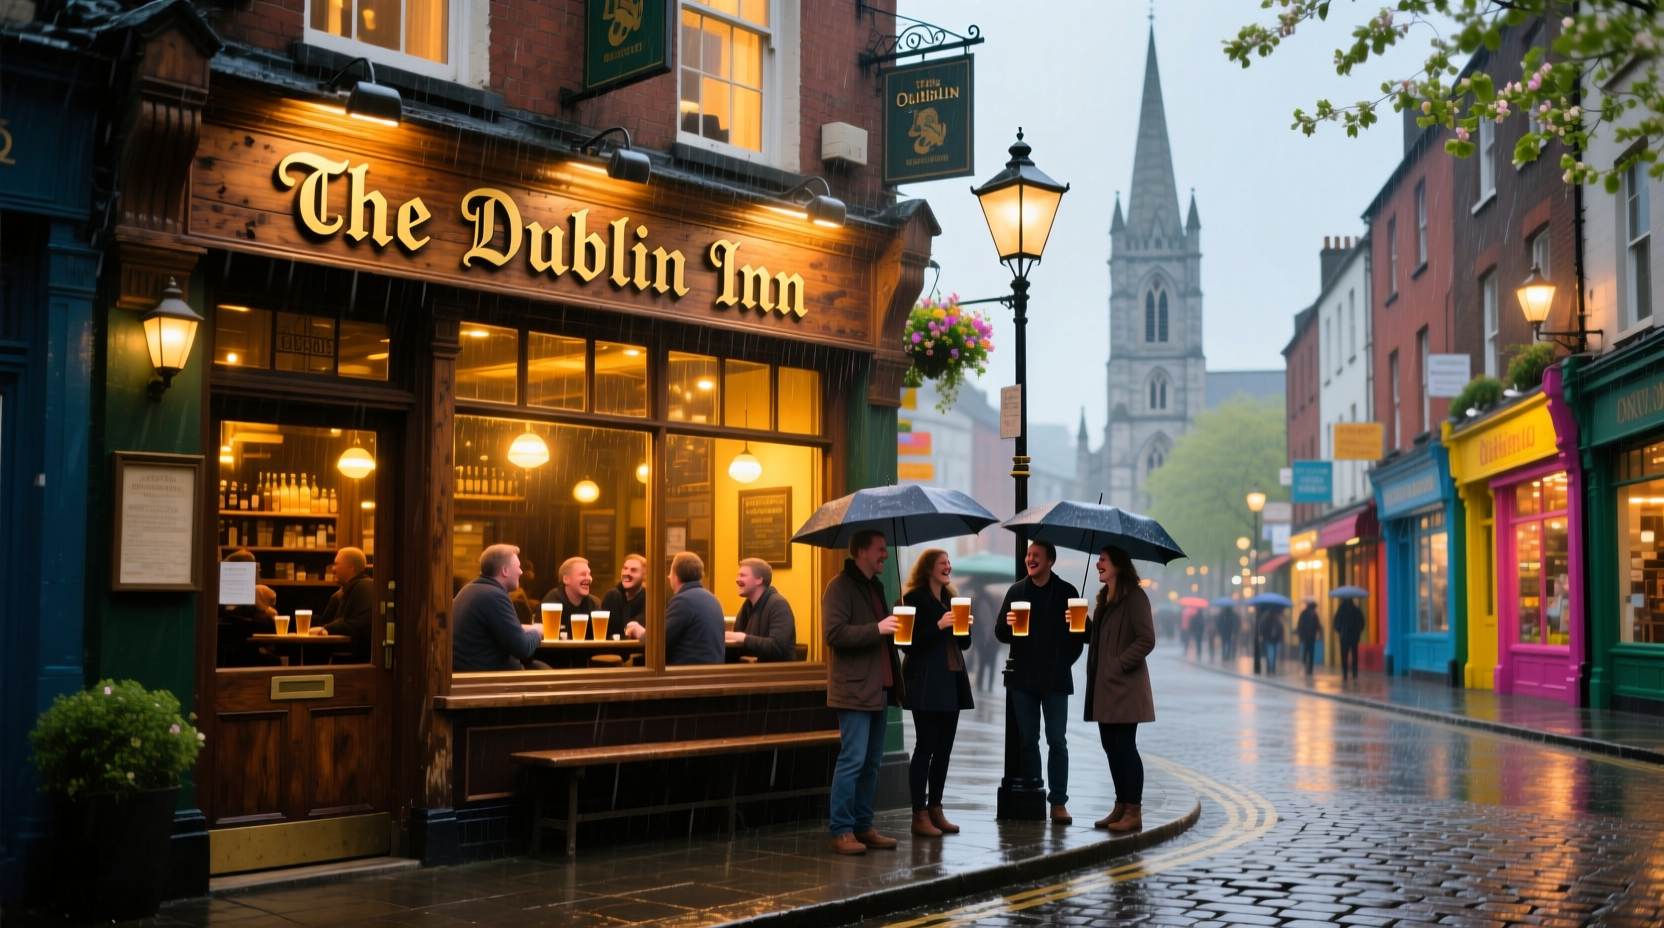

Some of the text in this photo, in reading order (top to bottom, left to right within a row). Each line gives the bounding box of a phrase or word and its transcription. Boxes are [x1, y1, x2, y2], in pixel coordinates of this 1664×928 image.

[278, 151, 809, 318] The Dublin Inn
